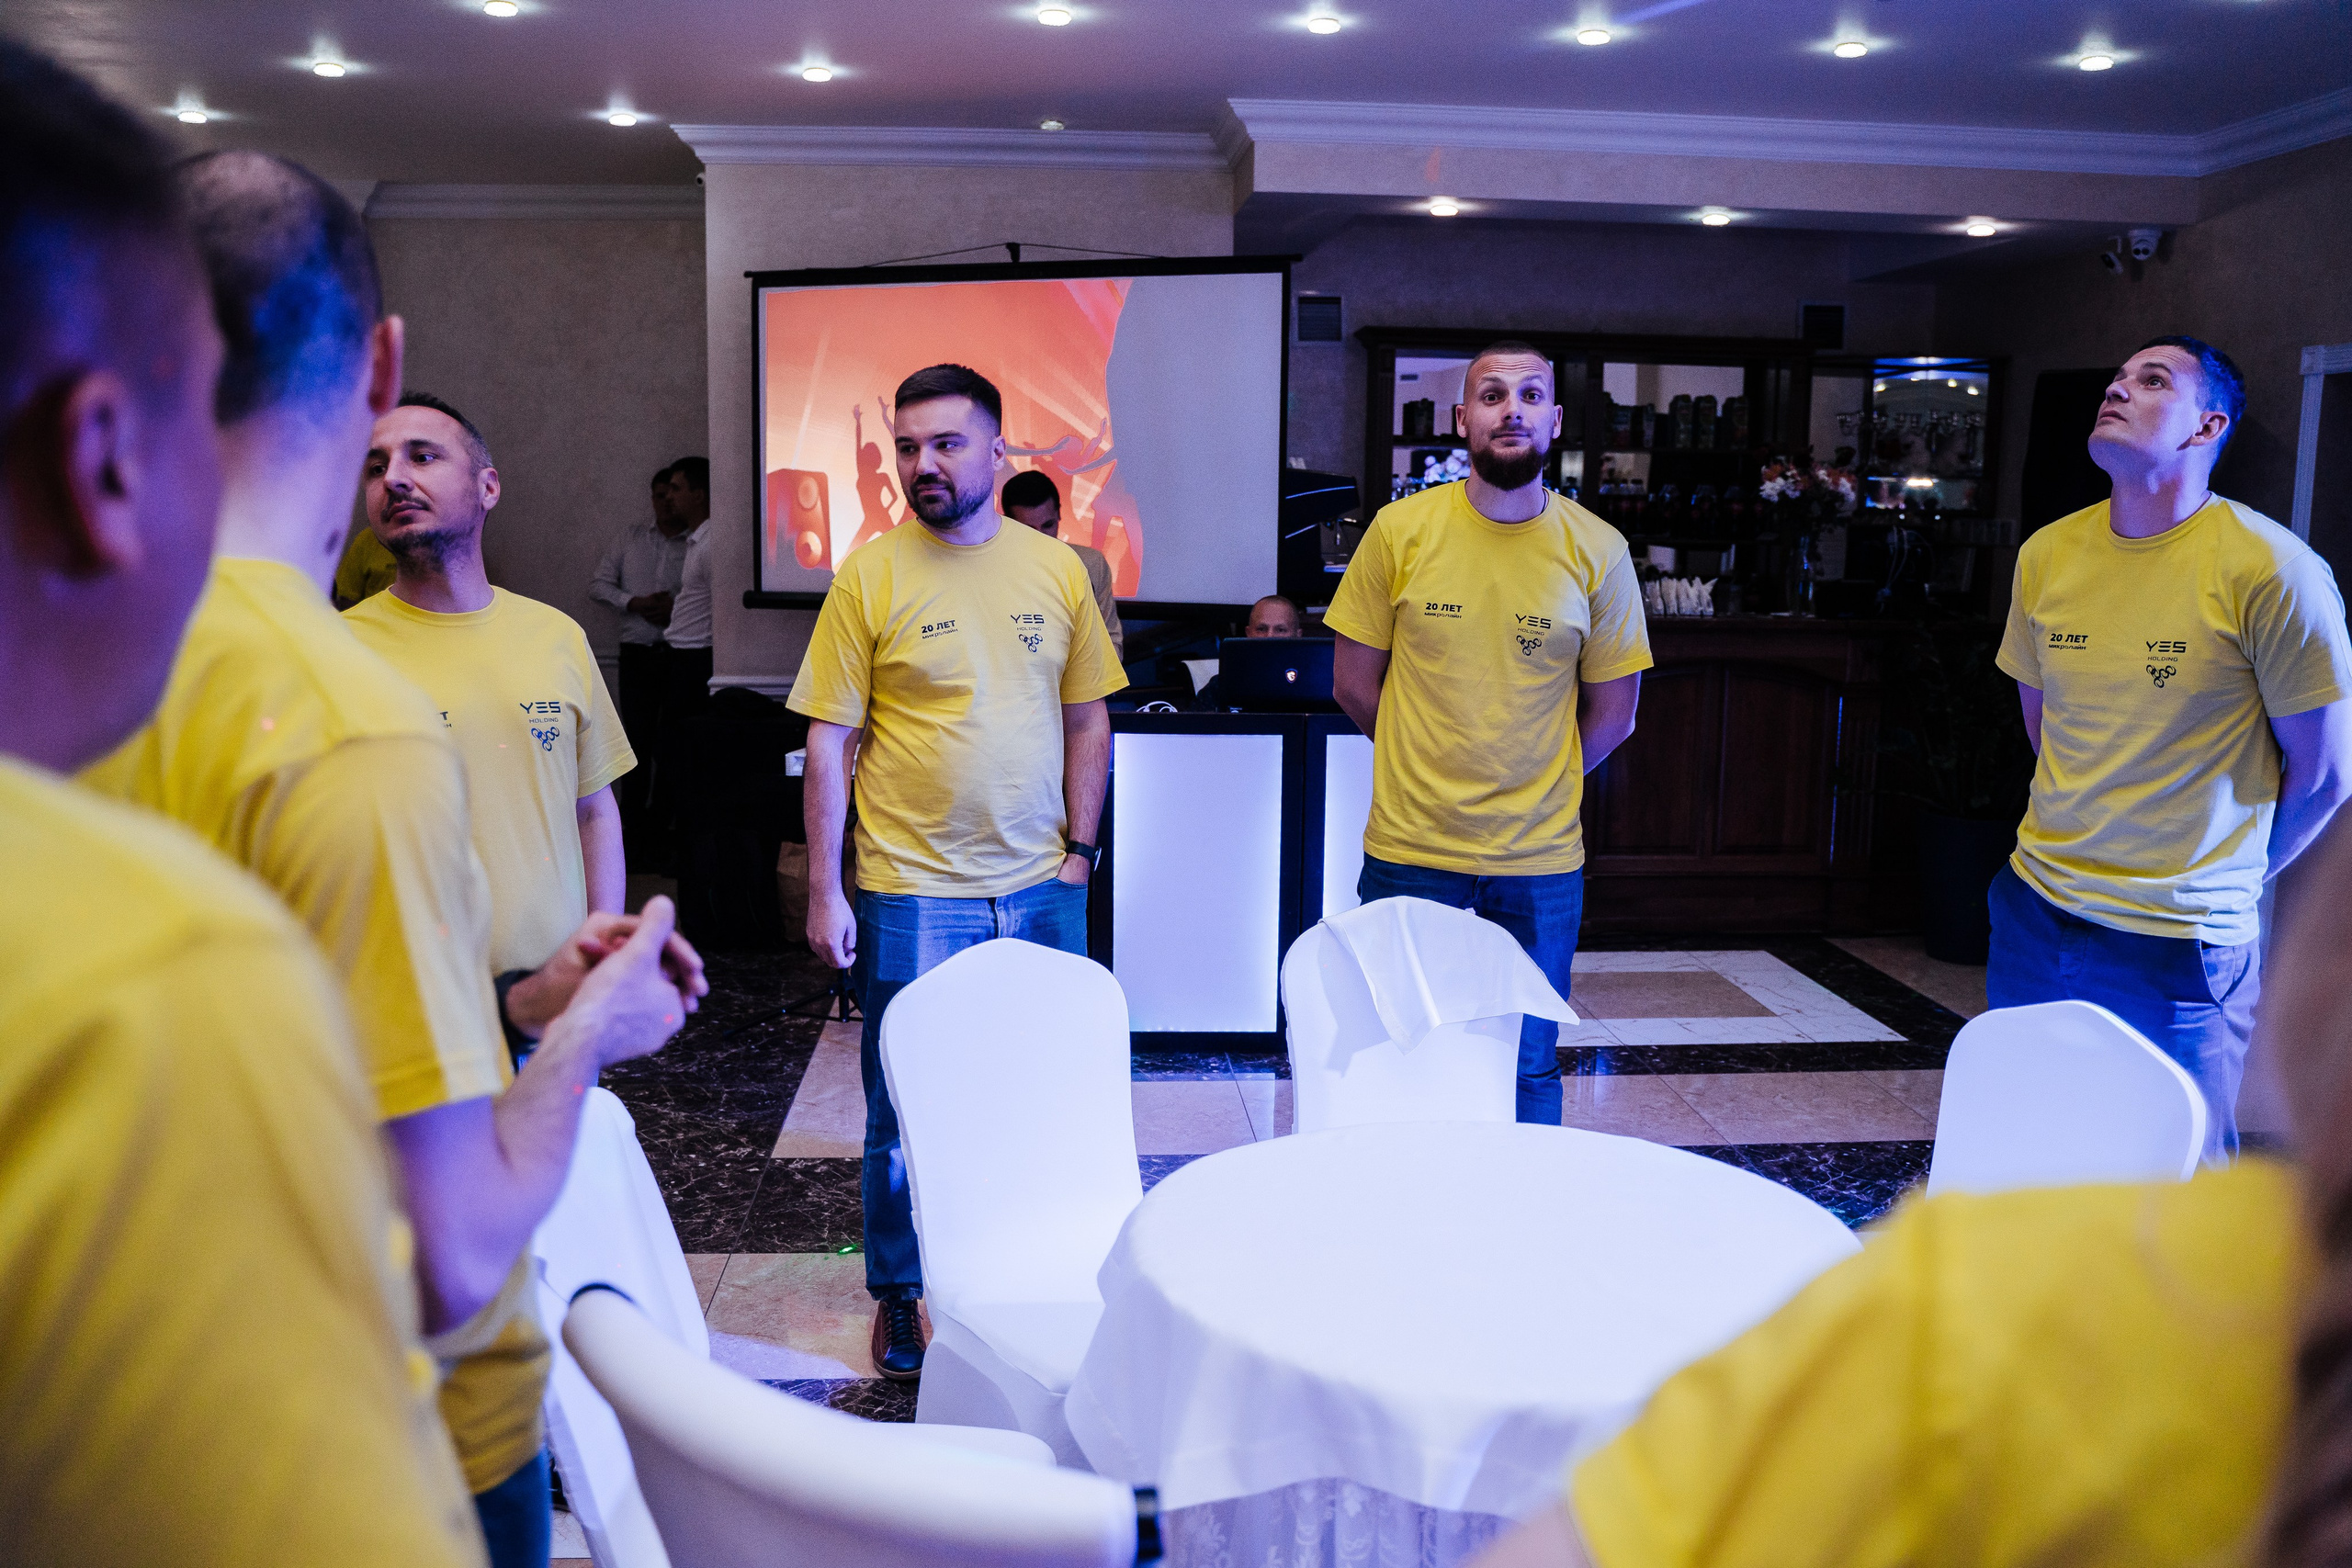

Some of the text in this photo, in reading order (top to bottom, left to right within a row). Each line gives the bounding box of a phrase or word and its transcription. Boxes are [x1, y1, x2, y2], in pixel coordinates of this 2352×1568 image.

[1425, 603, 1463, 613] 20 ЛЕТ
[1011, 615, 1045, 624] YES
[1515, 614, 1552, 629] YES
[921, 619, 956, 634] 20 ЛЕТ
[1517, 627, 1545, 636] HOLDING
[2050, 633, 2088, 643] 20 ЛЕТ
[2146, 641, 2188, 653] YES
[519, 702, 561, 714] YES
